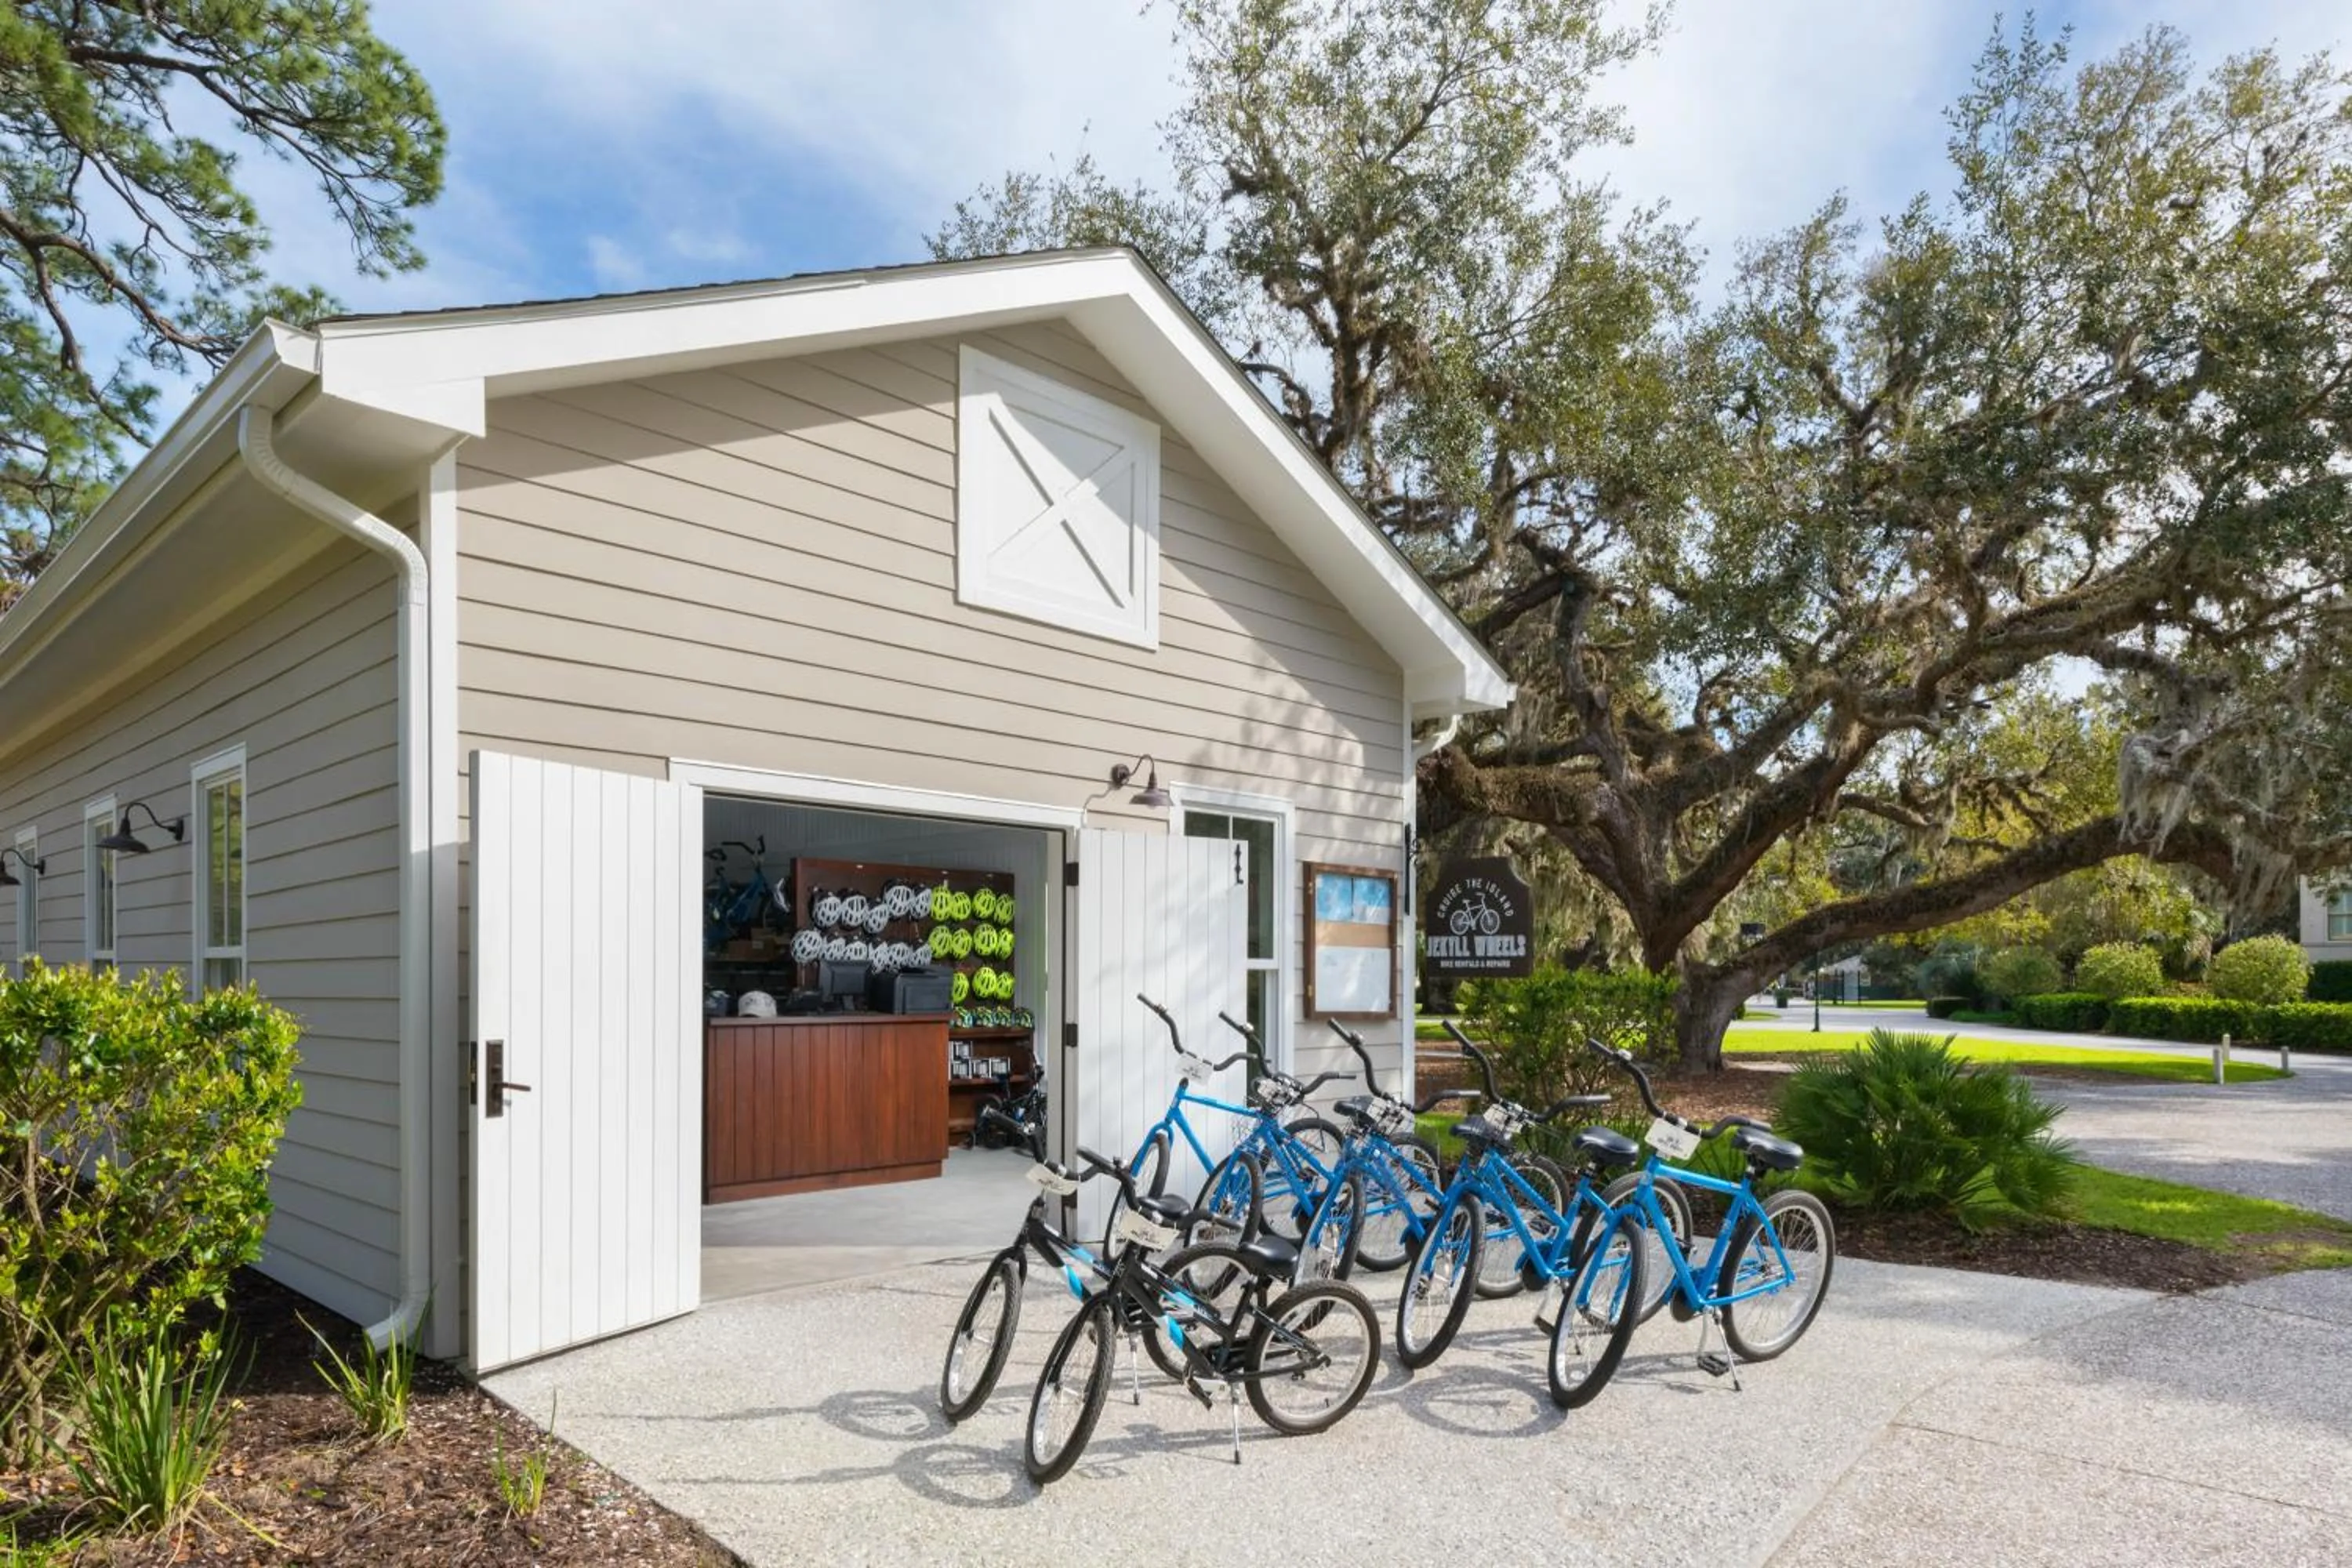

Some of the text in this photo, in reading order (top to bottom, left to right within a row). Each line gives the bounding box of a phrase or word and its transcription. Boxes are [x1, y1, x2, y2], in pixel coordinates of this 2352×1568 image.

[1465, 878, 1483, 888] THE
[1486, 881, 1514, 916] ISLAND
[1427, 935, 1526, 957] JEKYLL WHEELS
